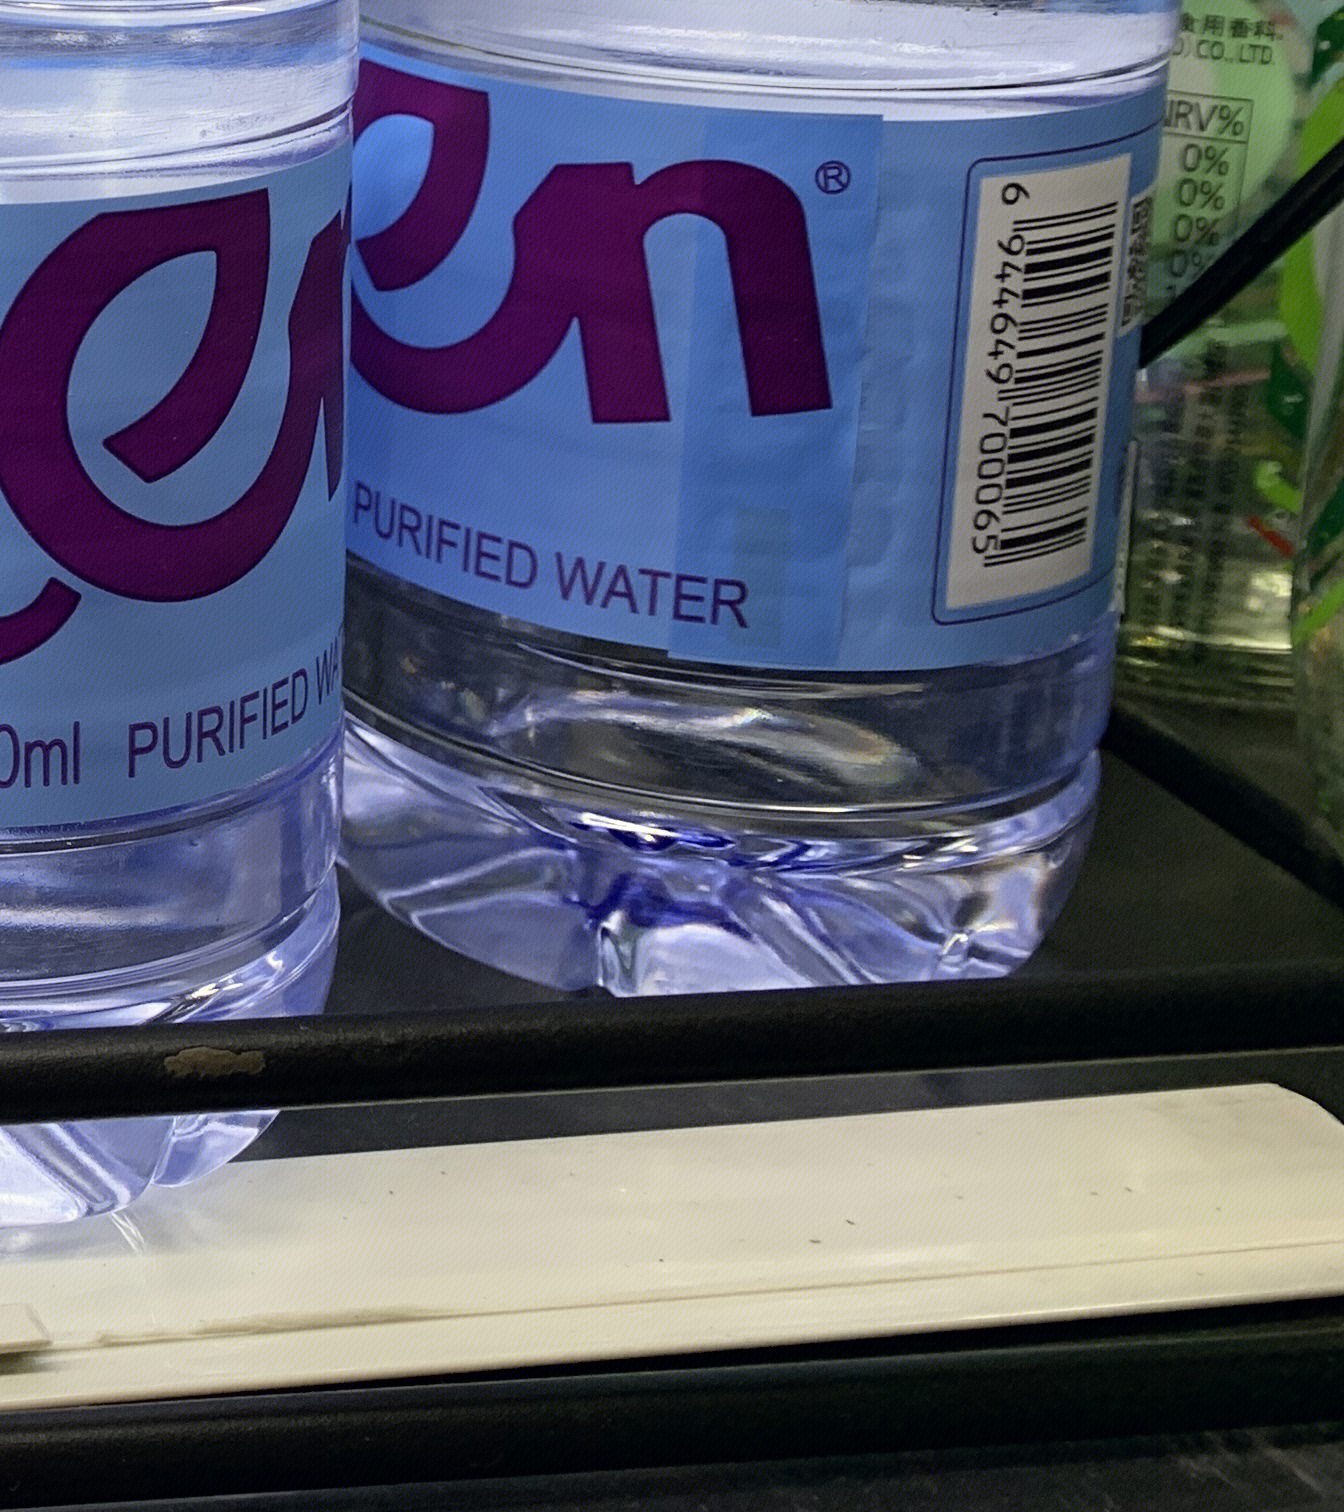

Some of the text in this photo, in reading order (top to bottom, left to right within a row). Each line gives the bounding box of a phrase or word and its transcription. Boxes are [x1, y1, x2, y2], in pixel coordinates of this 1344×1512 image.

[1177, 178, 1226, 211] 0%
[1181, 143, 1229, 176] 0%
[1173, 213, 1221, 246] 0%
[970, 181, 1030, 555] 6 944649 700065
[353, 480, 750, 629] PURIFIED WATER
[127, 668, 309, 779] PURIFIED
